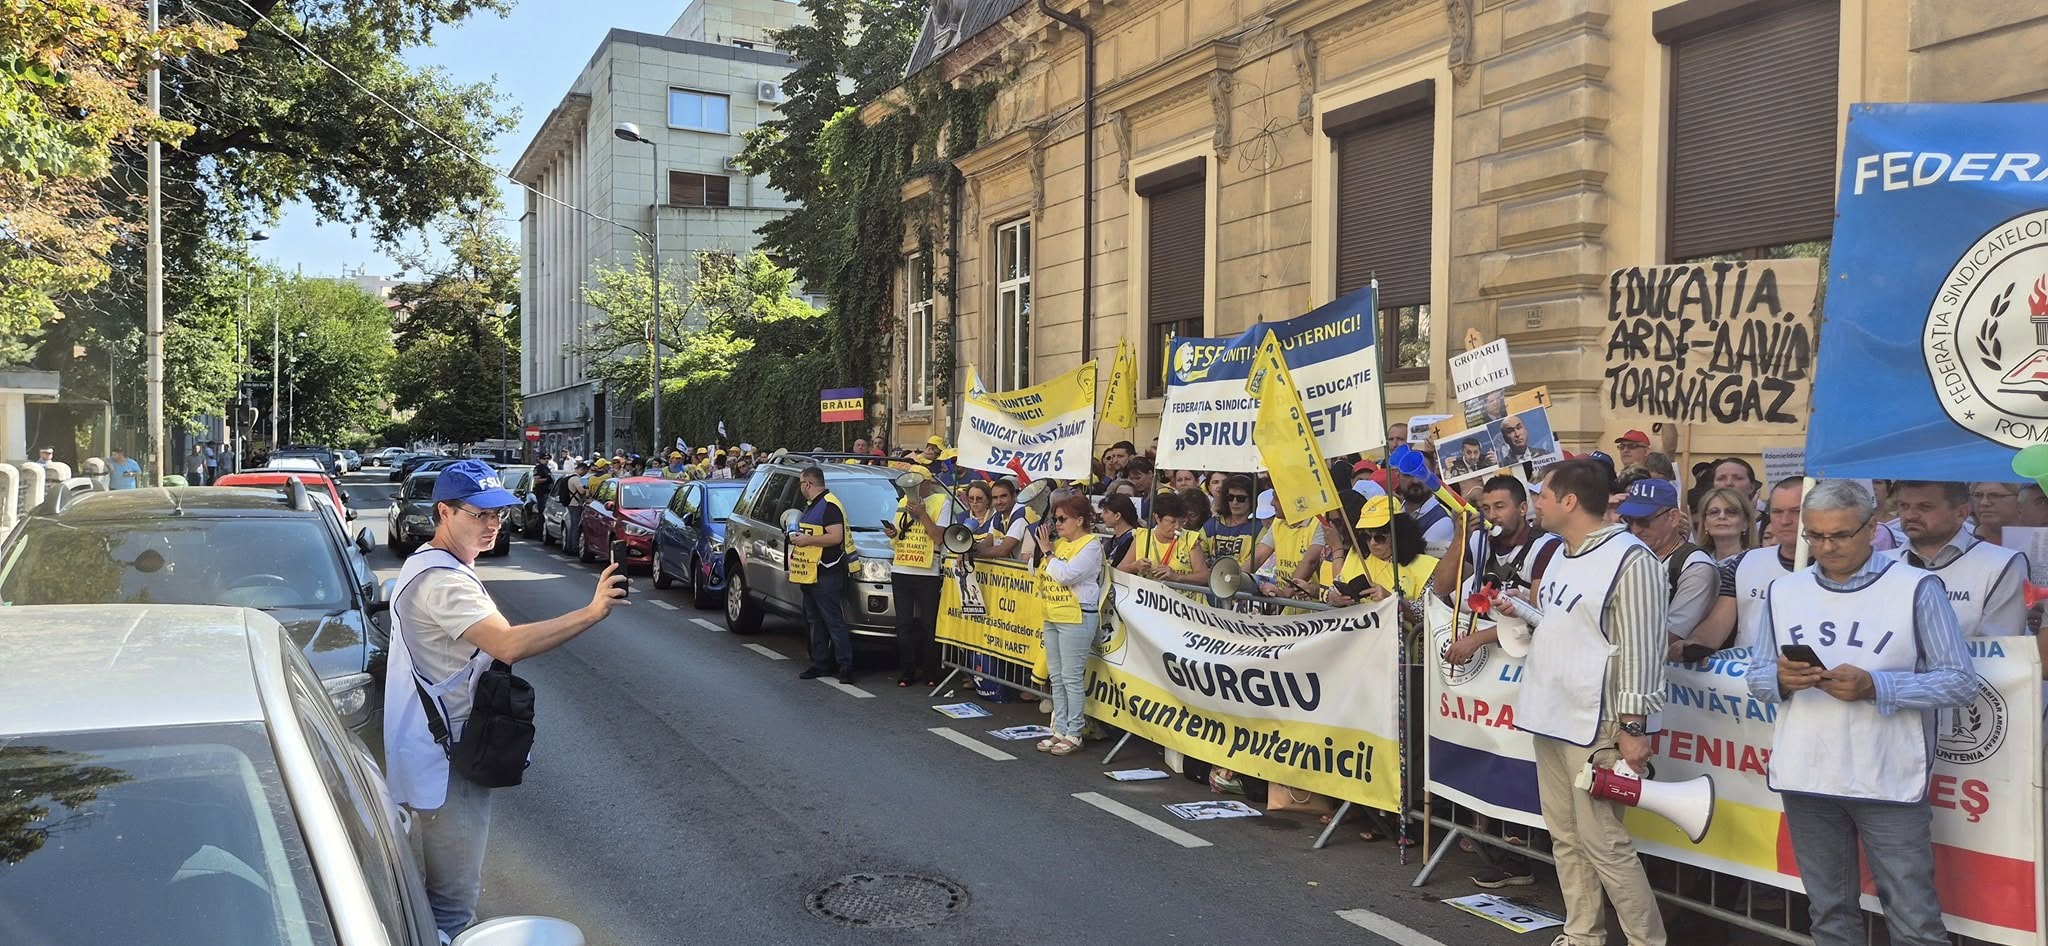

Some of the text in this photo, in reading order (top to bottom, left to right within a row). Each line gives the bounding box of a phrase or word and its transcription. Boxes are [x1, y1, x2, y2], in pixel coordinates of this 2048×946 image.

[1931, 311, 1971, 405] FEDERAȚIA
[1306, 369, 1371, 400] EDUCAȚIE
[1709, 374, 1799, 424] GAZ
[970, 416, 1018, 444] SINDICAT
[1054, 449, 1064, 472] 5
[998, 597, 1016, 614] CLUJ
[1135, 588, 1217, 628] SINDICATUL
[1162, 652, 1321, 712] GIURGIU
[1128, 694, 1227, 746] suntem
[1227, 724, 1374, 783] puternici!
